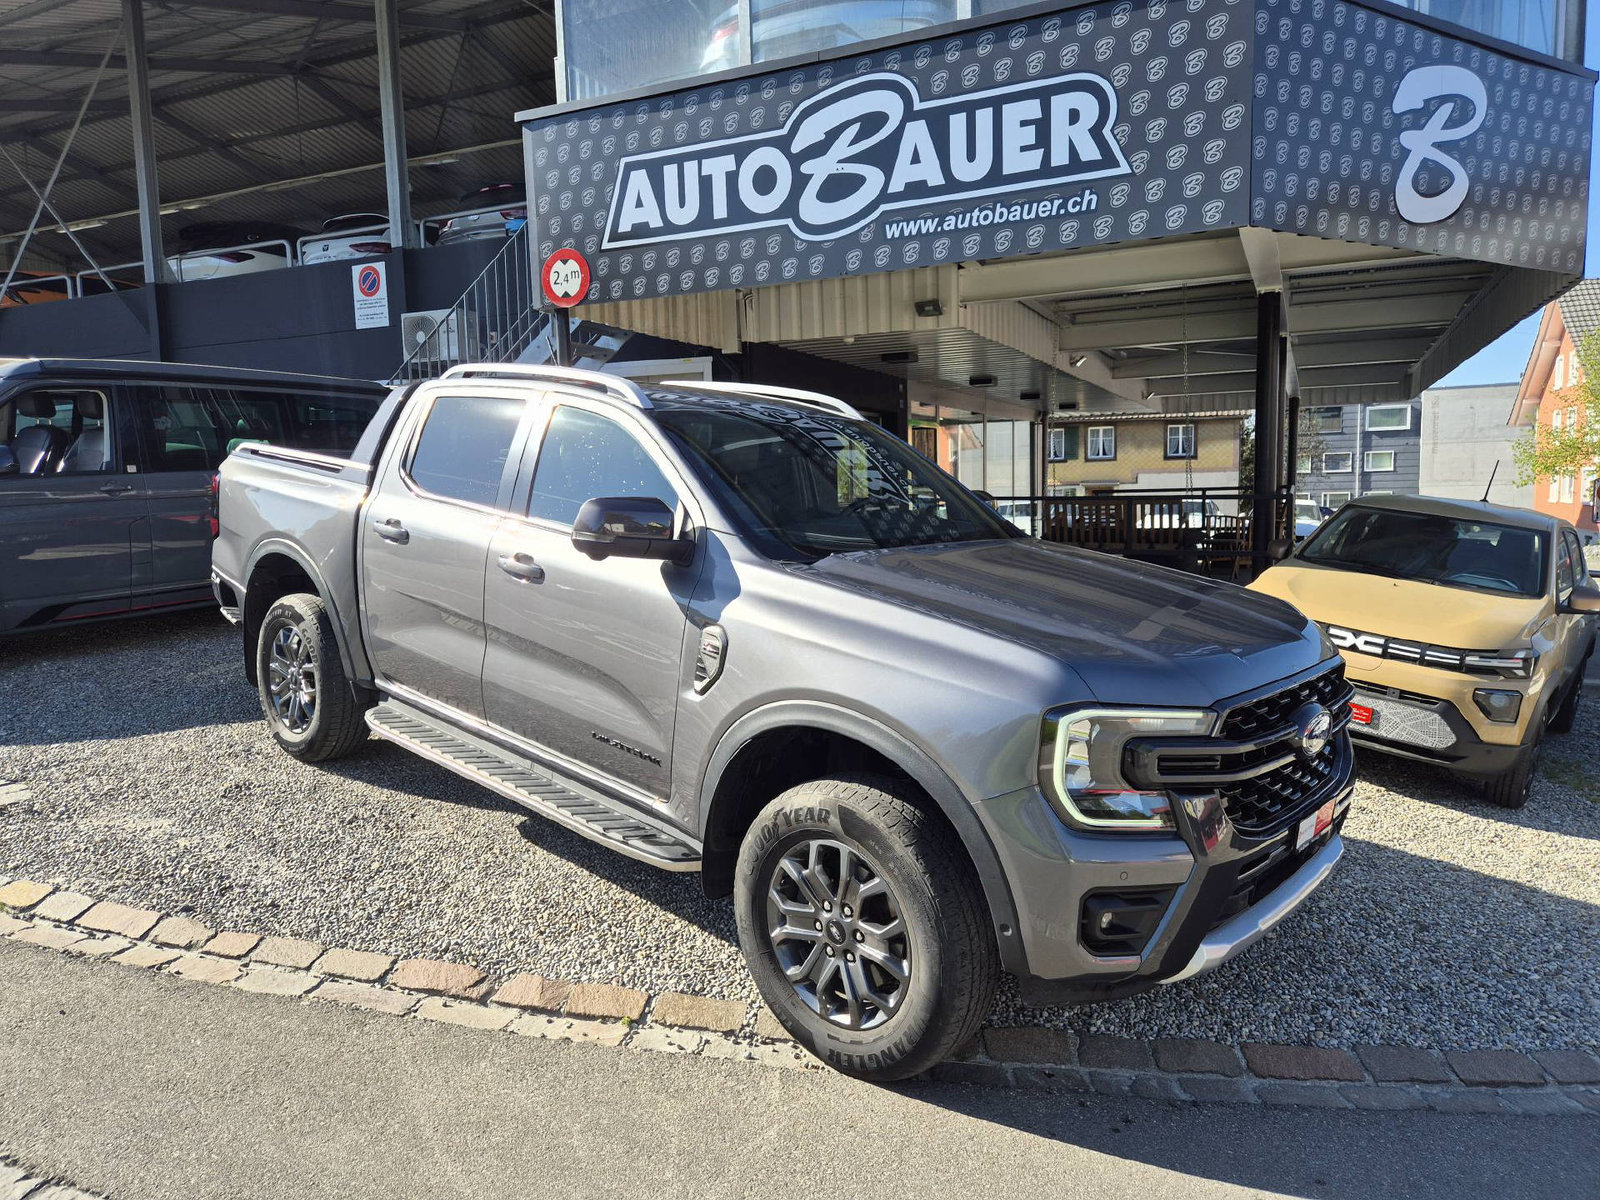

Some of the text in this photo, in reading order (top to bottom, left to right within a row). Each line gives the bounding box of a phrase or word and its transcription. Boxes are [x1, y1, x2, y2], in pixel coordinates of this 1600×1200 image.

[617, 89, 1103, 232] AUTO BAUER
[885, 190, 1098, 239] www.autobauer.ch
[1392, 65, 1487, 223] B
